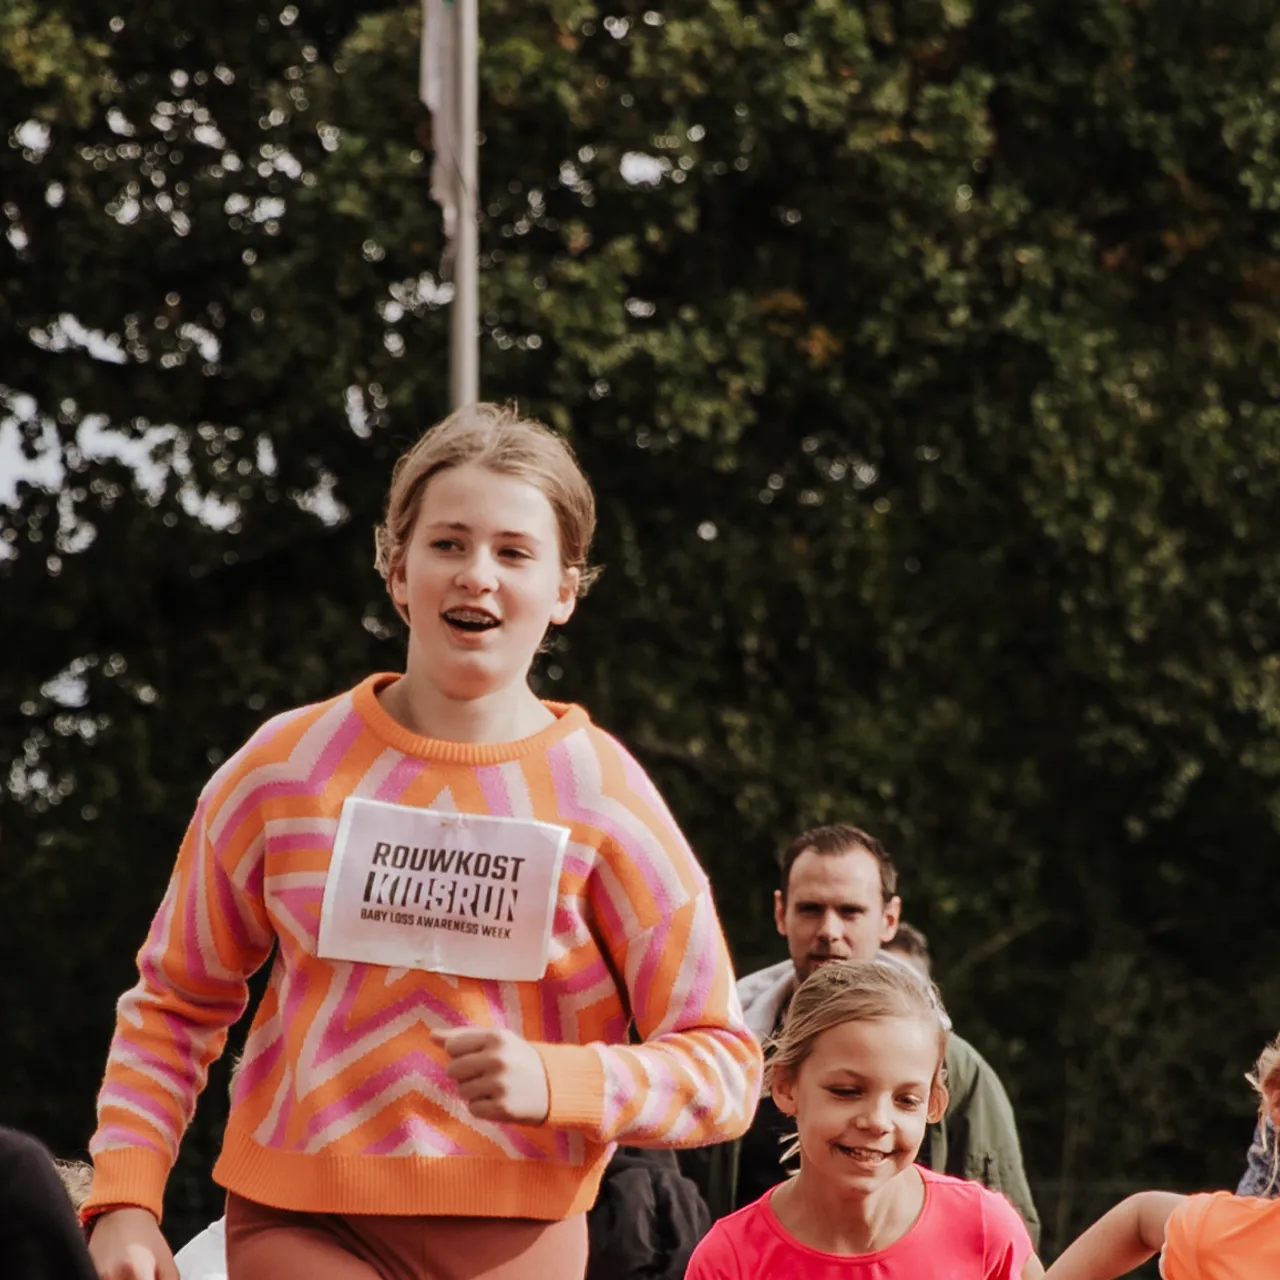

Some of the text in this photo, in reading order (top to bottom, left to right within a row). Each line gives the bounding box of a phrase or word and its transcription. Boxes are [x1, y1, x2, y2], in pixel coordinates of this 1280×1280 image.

[371, 842, 525, 882] ROUWKOST
[363, 871, 519, 922] KIDSRUN
[360, 908, 512, 940] BABY LOSS AWARENESS WEEK
